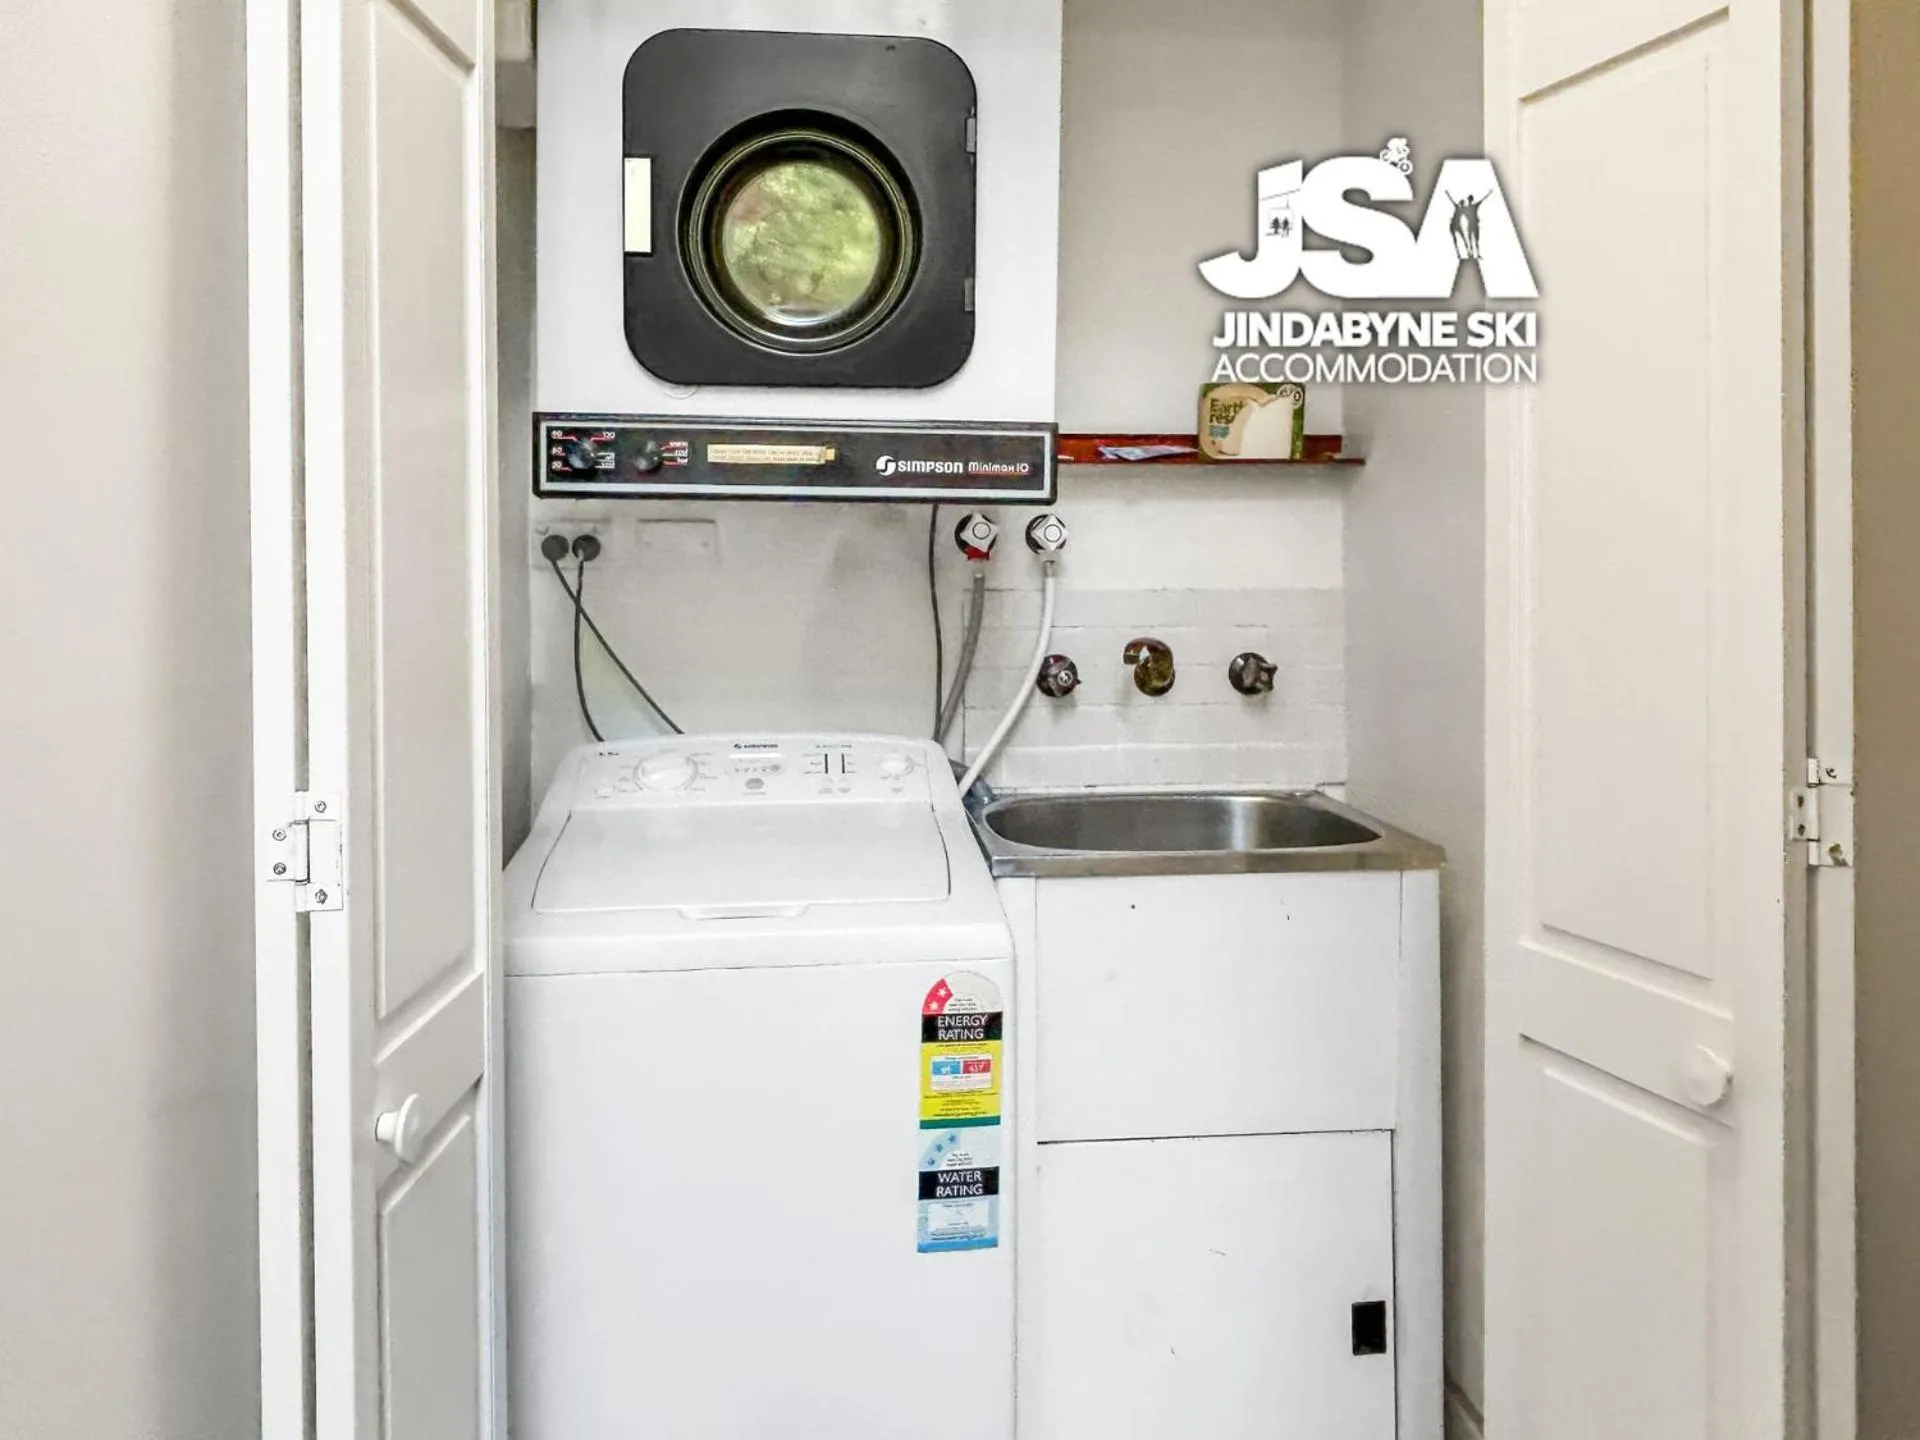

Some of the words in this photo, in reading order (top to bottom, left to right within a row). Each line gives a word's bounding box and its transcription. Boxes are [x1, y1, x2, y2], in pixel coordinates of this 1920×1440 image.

[898, 460, 963, 474] SIMPSON
[937, 1014, 988, 1027] ENERGY
[938, 1028, 984, 1041] RATING
[938, 1170, 982, 1183] WATER
[936, 1184, 983, 1197] RATING
